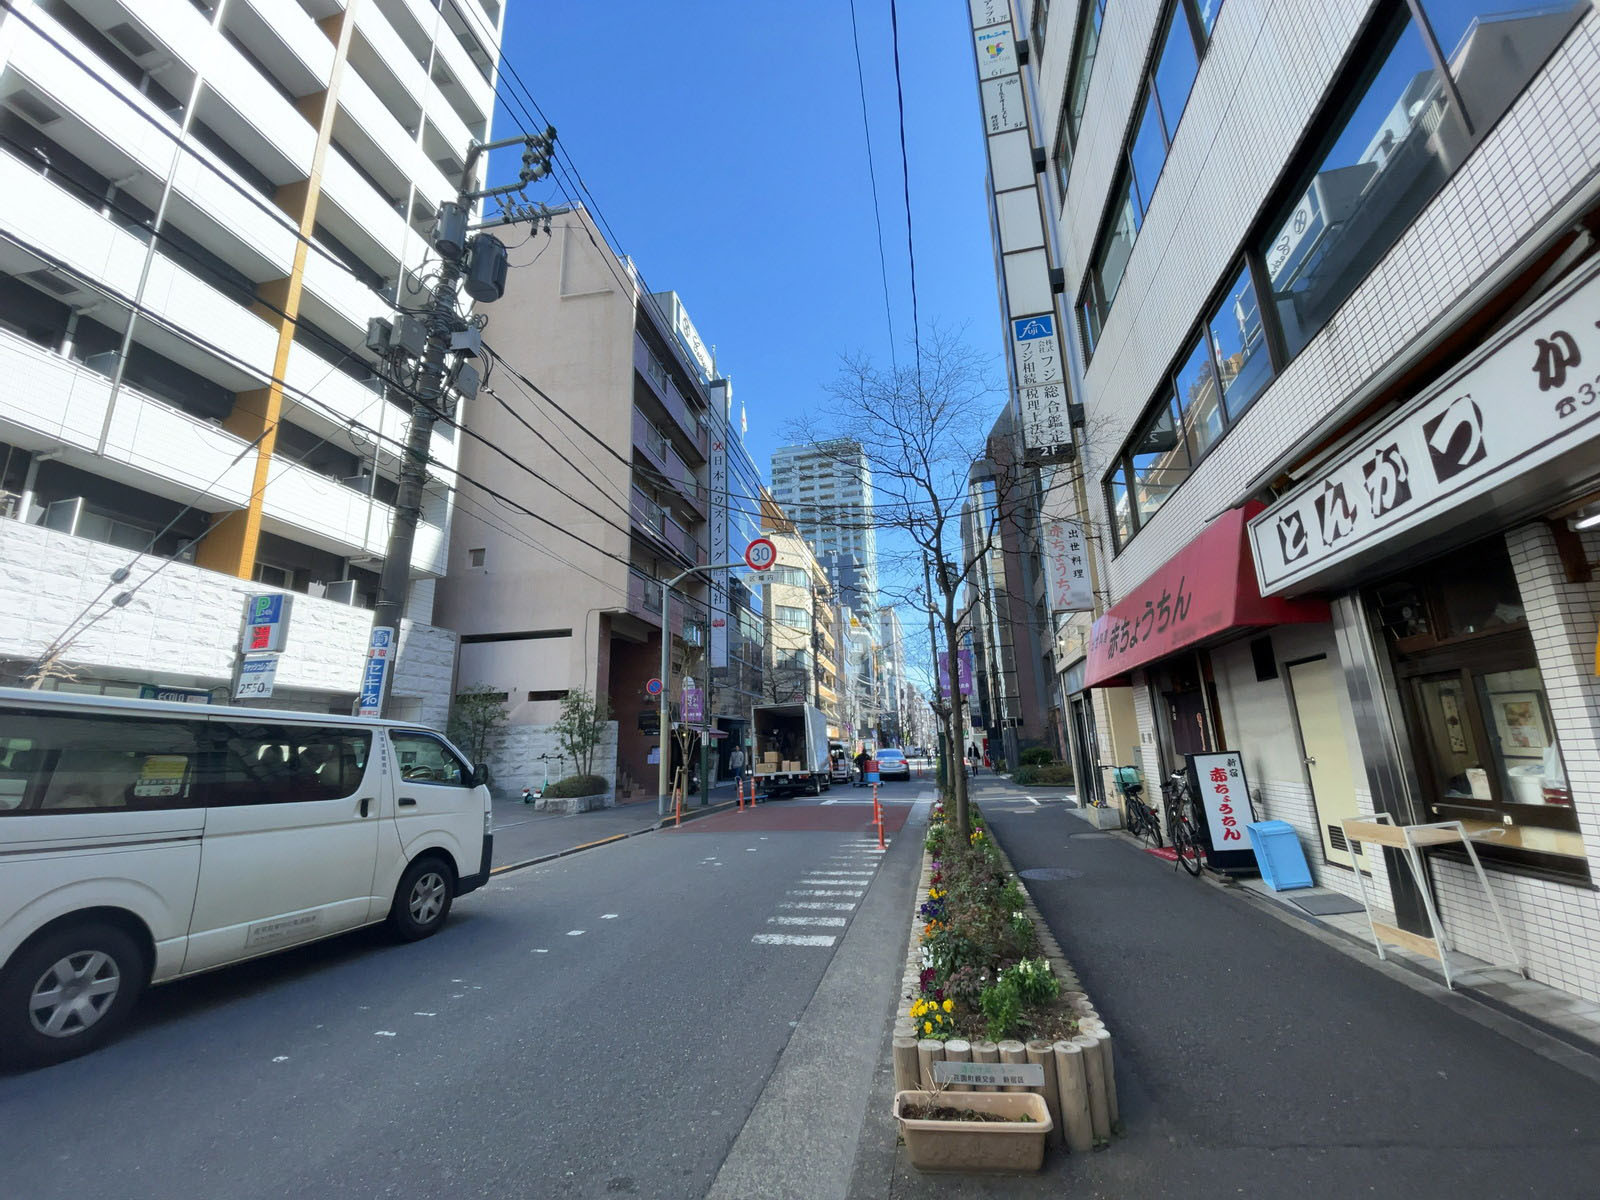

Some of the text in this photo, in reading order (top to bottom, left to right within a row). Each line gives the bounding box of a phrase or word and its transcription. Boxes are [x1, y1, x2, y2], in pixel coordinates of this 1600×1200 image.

[1040, 445, 1058, 457] 2F
[1277, 393, 1488, 566] とんかつ
[752, 547, 770, 561] 30
[1049, 524, 1072, 606] 赤ちょうちん
[1068, 529, 1084, 579] 出世料理
[1108, 576, 1191, 660] 赤ちょうちん
[1227, 758, 1239, 778] 新宿
[1210, 767, 1241, 841] 赤ちょうちん
